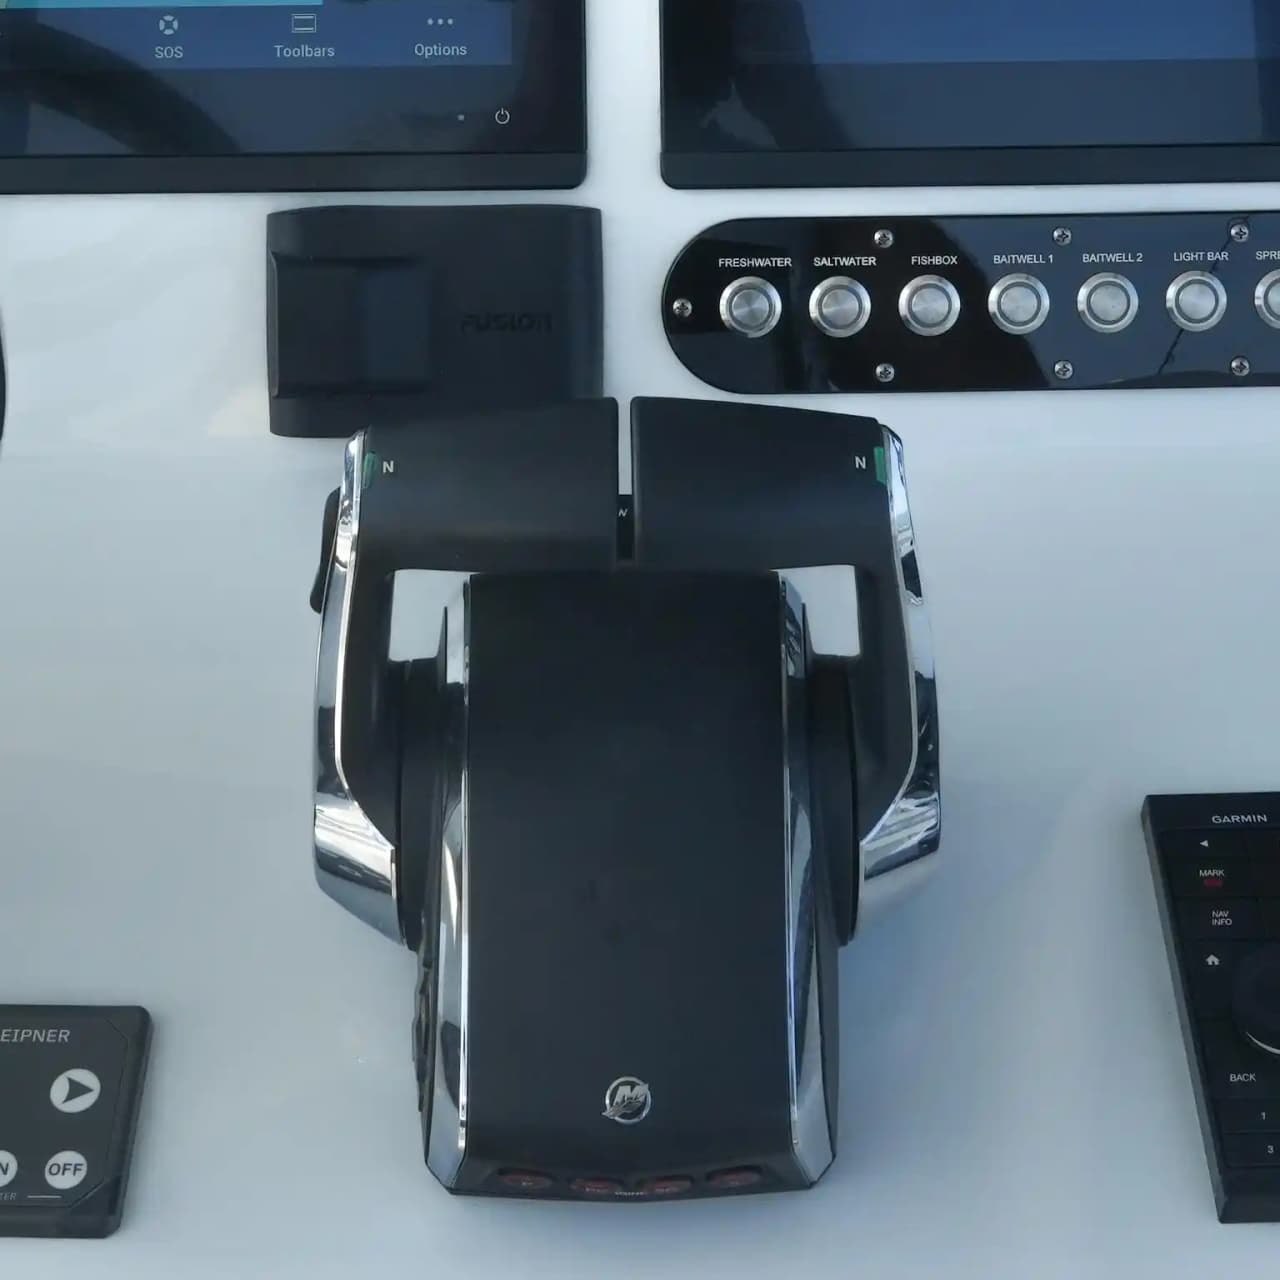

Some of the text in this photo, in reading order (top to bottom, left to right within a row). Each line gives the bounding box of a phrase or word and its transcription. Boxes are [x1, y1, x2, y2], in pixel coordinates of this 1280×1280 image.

[153, 45, 184, 60] SOS
[274, 43, 336, 58] Toolbars
[414, 43, 468, 59] Options
[718, 256, 793, 269] FRESHWATER
[813, 256, 877, 268] SALTWATER
[911, 255, 958, 266] FISHBOX
[993, 253, 1046, 265] BAITWELL
[1082, 252, 1144, 264] BAITWELL 2
[1173, 251, 1229, 262] LIGHT BAR
[383, 460, 395, 474] N
[855, 456, 867, 469] N
[1211, 814, 1268, 824] GARMIN
[1199, 869, 1225, 878] MARK
[1229, 1073, 1257, 1083] BACK
[48, 1162, 84, 1177] OFF
